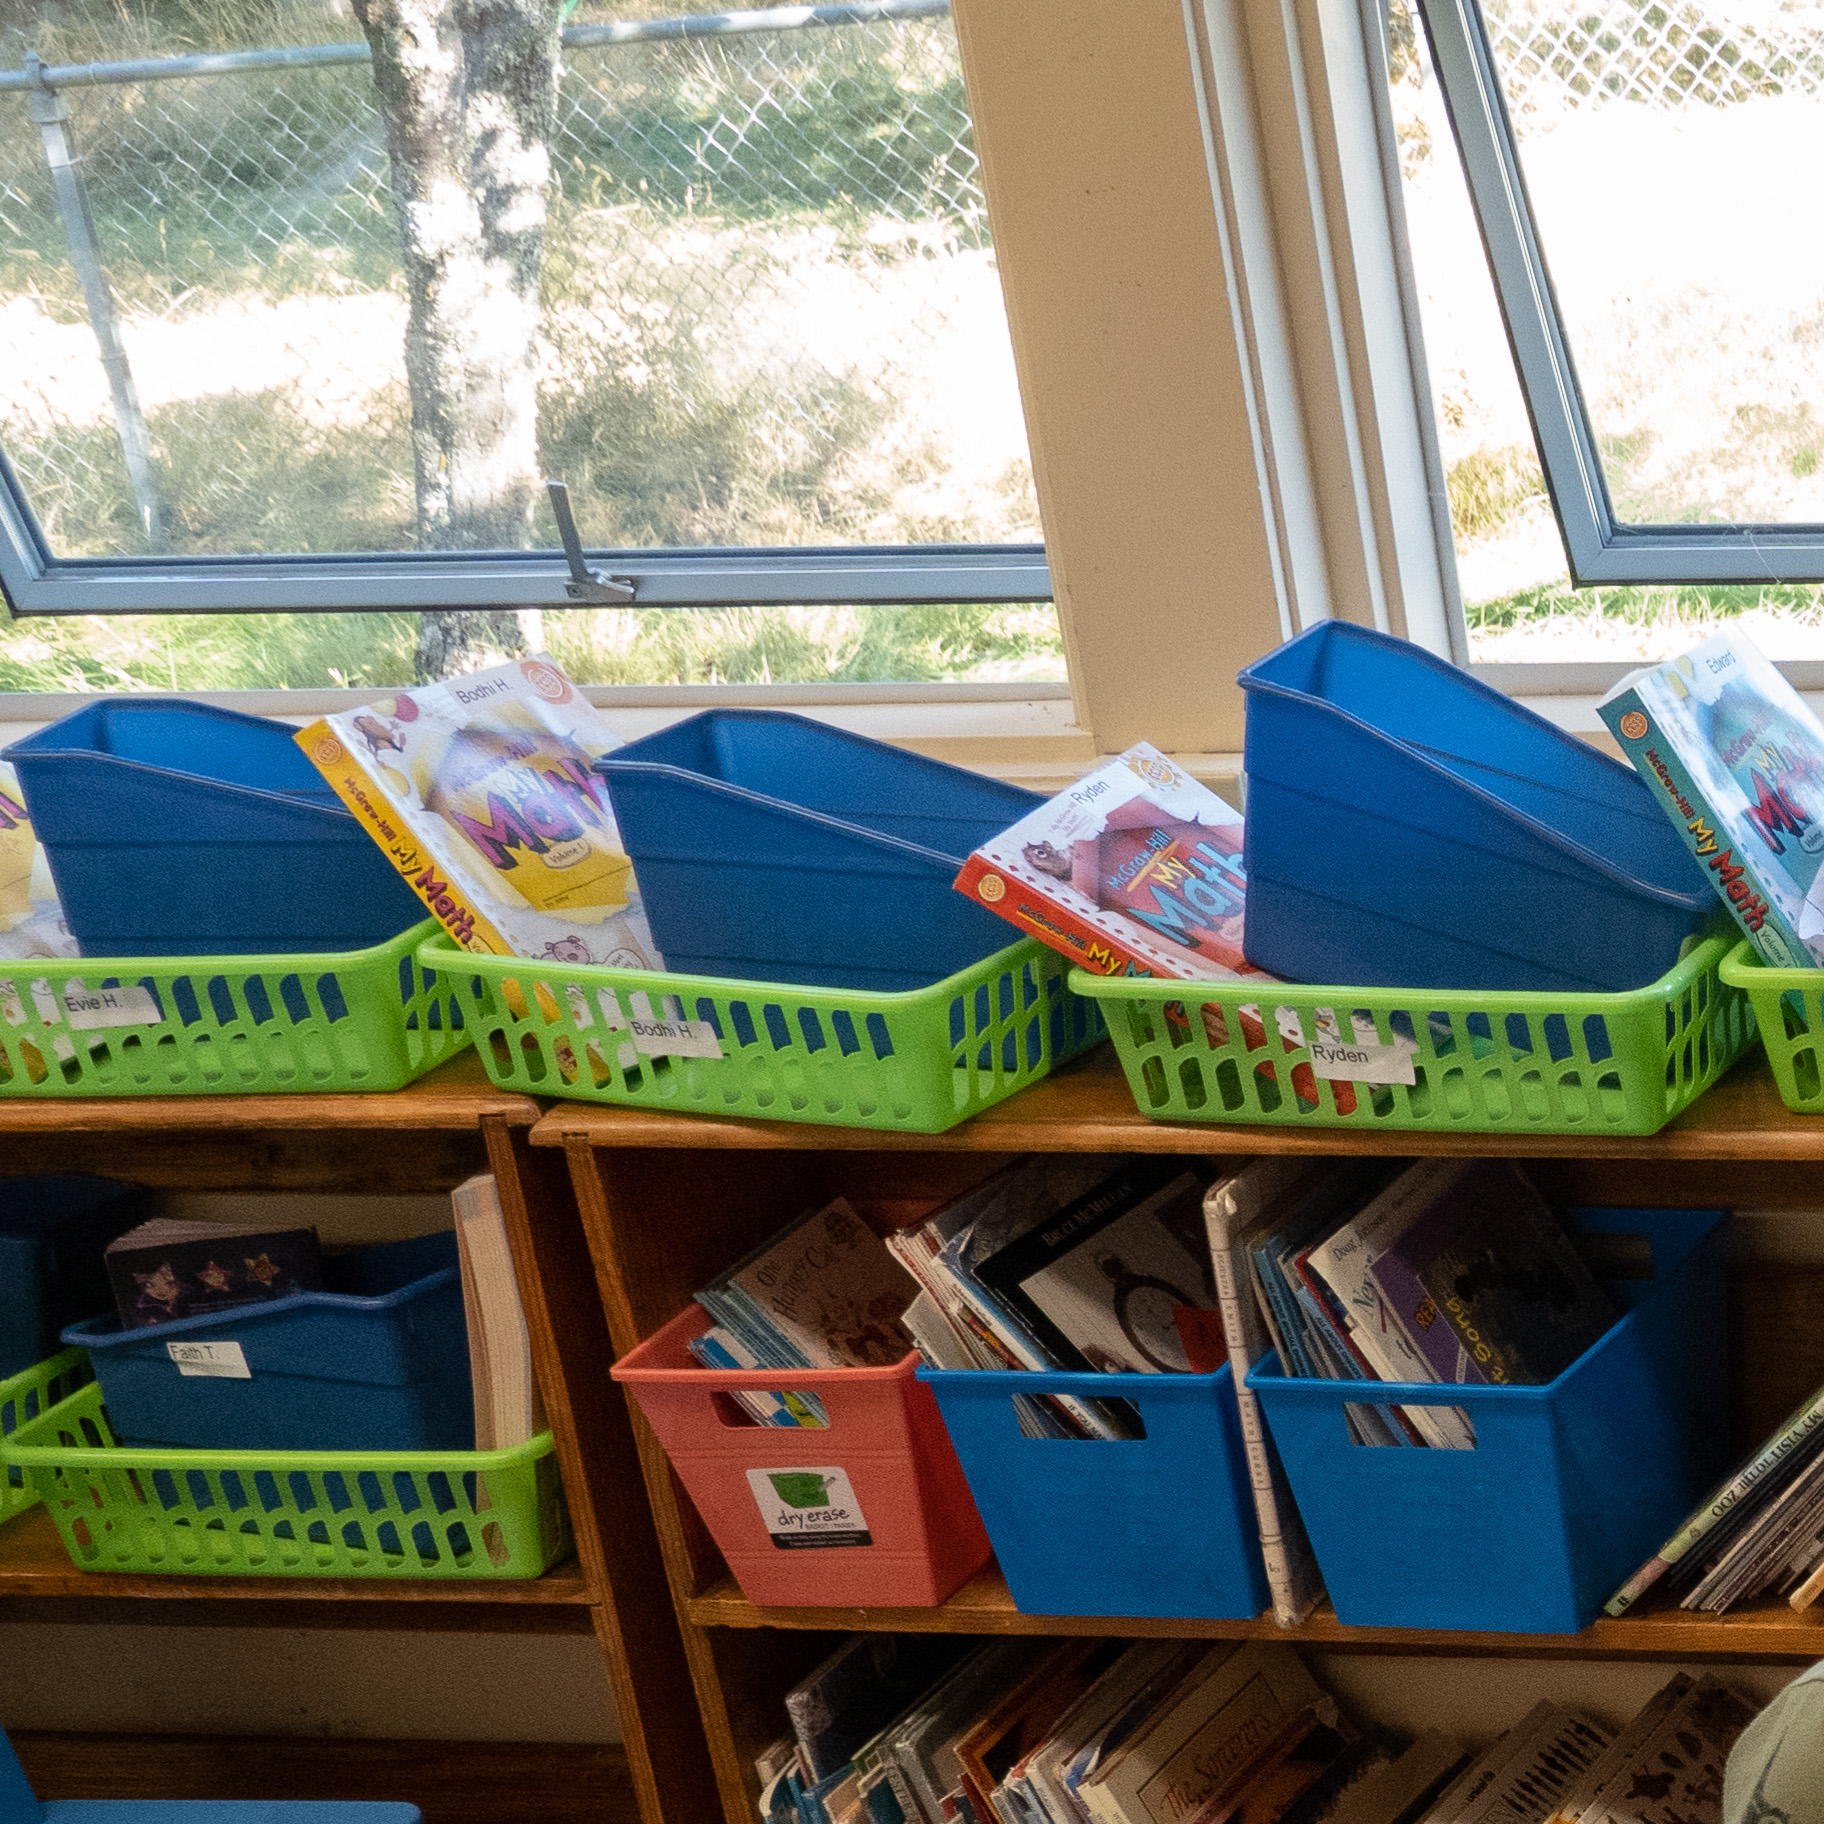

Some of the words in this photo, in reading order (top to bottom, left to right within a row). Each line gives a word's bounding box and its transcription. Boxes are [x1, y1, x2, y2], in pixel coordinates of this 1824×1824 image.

[1705, 650, 1738, 676] Edward
[456, 681, 496, 705] Bodhi
[1072, 778, 1111, 806] Ryden
[1644, 747, 1696, 821] McGraw-Hill
[1687, 814, 1720, 858] My
[1709, 847, 1770, 933] Math
[344, 778, 397, 841] McGraw-Hill
[390, 836, 424, 877] My
[413, 867, 477, 944] Math
[1106, 829, 1174, 892] McGraw-Hill
[1152, 856, 1196, 890] My
[1126, 841, 1247, 948] Math
[1086, 941, 1122, 977] My
[65, 995, 101, 1014] Evie
[102, 993, 123, 1010] H.
[630, 1020, 675, 1041] Bodhi
[678, 1022, 699, 1040] H.
[1311, 1043, 1370, 1068] Ryden
[1039, 1216, 1081, 1250] BRUCE
[1330, 1235, 1359, 1263] Doug
[752, 1258, 787, 1292] One
[759, 1257, 830, 1327] Hungry
[1324, 1328, 1343, 1351] ABOUT
[1438, 1293, 1500, 1365] Song
[169, 1343, 204, 1361] Faith
[1799, 1408, 1822, 1432] MY
[1767, 1427, 1804, 1462] VISIT
[1753, 1455, 1772, 1474] TO
[1734, 1468, 1760, 1493] THE
[1709, 1488, 1739, 1518] ZOO
[777, 1508, 804, 1530] dry
[806, 1507, 851, 1523] erase
